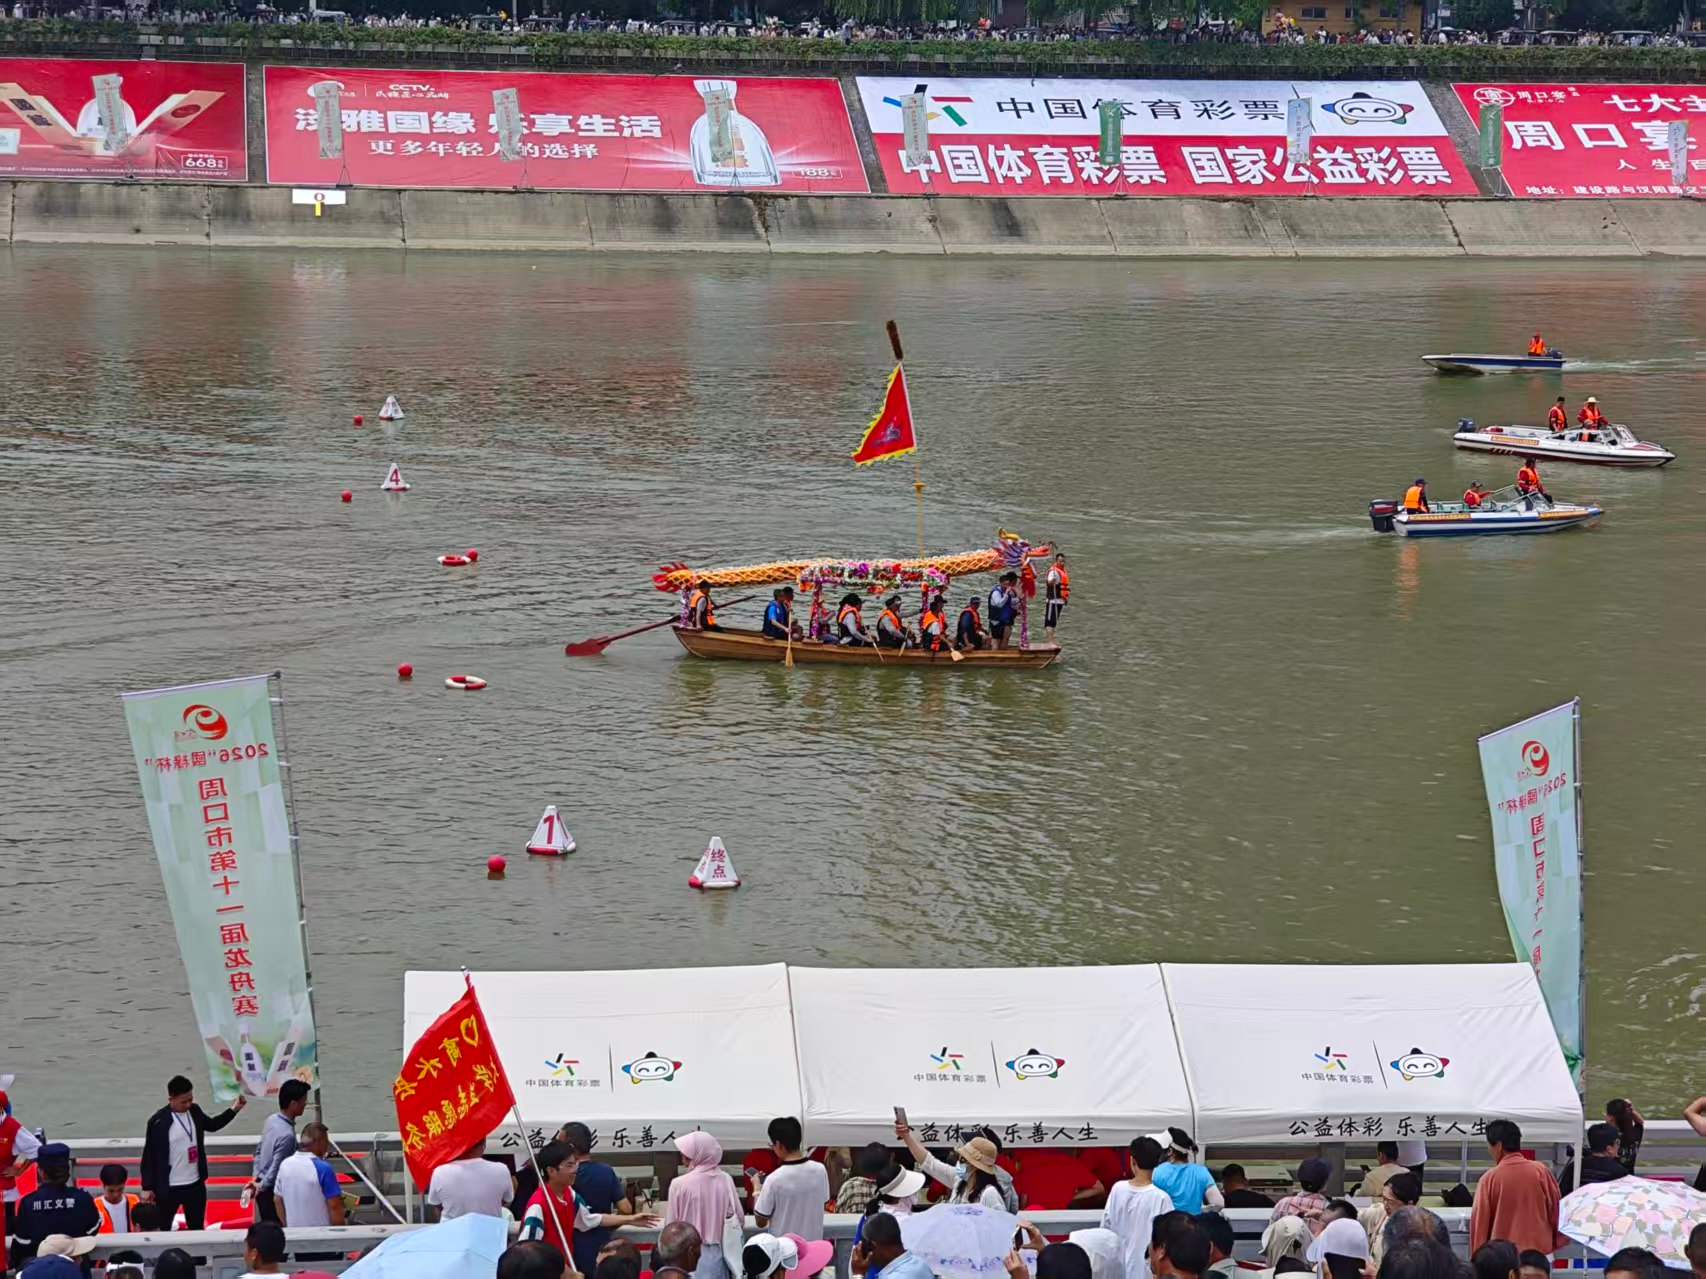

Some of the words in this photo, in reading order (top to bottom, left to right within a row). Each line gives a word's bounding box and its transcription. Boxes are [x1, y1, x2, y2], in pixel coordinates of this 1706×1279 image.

[186, 158, 216, 168] 668
[898, 143, 1167, 185] 中国体育彩票
[1181, 144, 1452, 185] 国家公益彩票
[389, 468, 401, 486] 4
[543, 815, 555, 844] 1
[710, 848, 728, 879] 终点
[525, 1078, 601, 1088] 中国体育彩票
[913, 1073, 988, 1083] 中国体育彩票
[1301, 1072, 1374, 1084] 中国体育彩票
[500, 1127, 599, 1149] 公益
[612, 1124, 702, 1149] 乐善人
[896, 1121, 990, 1143] 益体
[1003, 1121, 1099, 1143] 乐善人生
[1288, 1116, 1383, 1138] 公益体彩
[1397, 1116, 1488, 1138] 乐善人生
